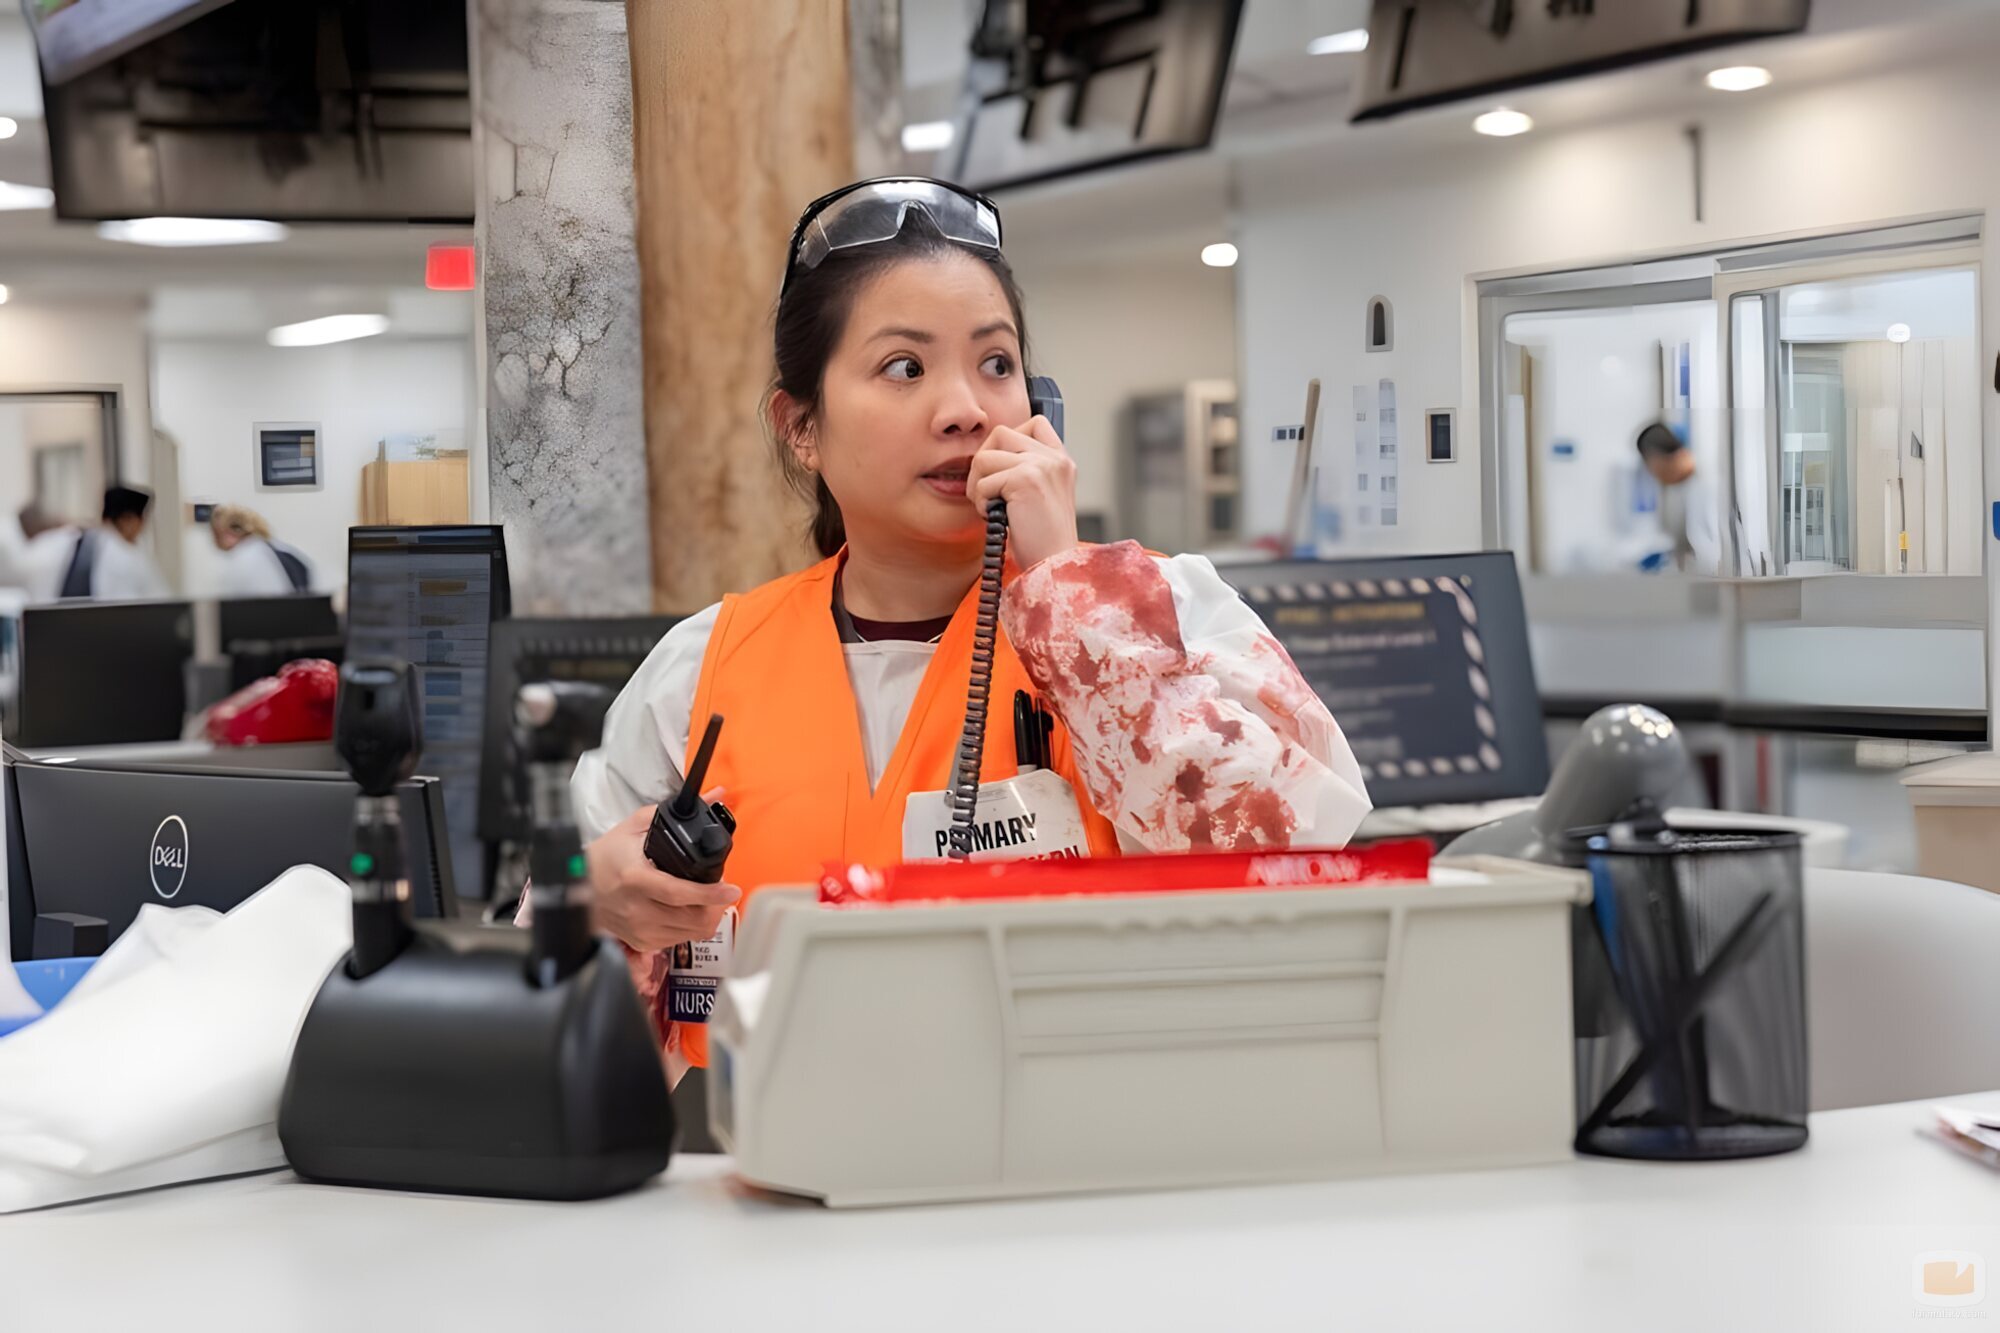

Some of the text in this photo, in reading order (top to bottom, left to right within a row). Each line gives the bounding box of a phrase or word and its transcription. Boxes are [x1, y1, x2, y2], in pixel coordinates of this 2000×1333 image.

[935, 812, 1037, 857] PMARY
[154, 846, 184, 868] DELL
[675, 991, 716, 1014] NURS
